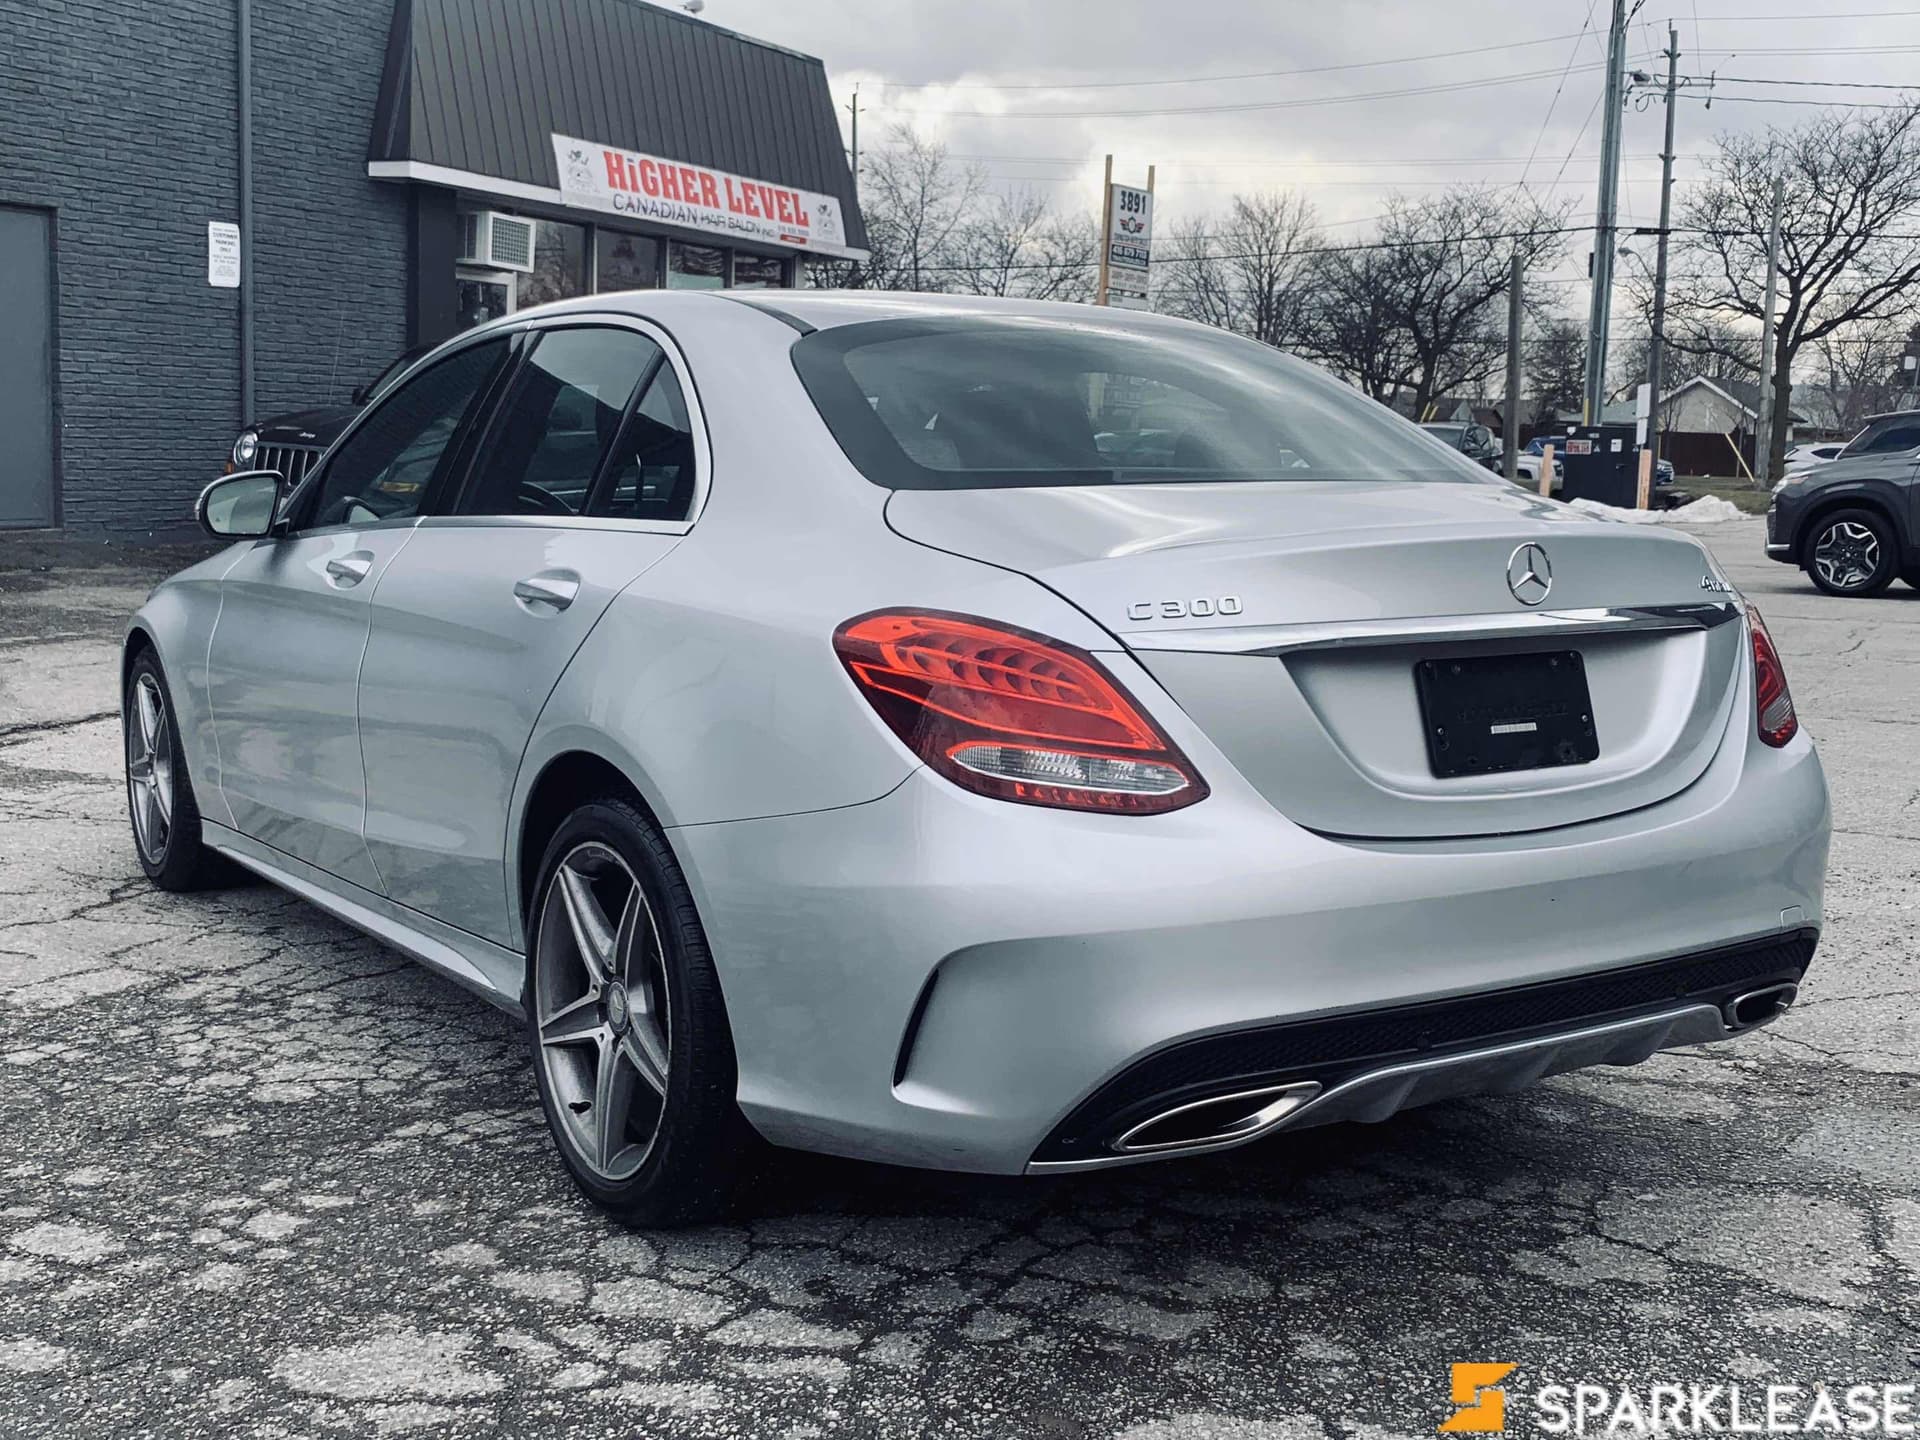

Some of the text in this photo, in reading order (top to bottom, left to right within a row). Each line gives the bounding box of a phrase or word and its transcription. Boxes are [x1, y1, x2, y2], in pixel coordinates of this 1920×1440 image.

[613, 193, 698, 225] CANADIAN
[724, 177, 810, 228] LEVEL
[1120, 190, 1147, 215] 3891
[1127, 596, 1243, 621] C 300
